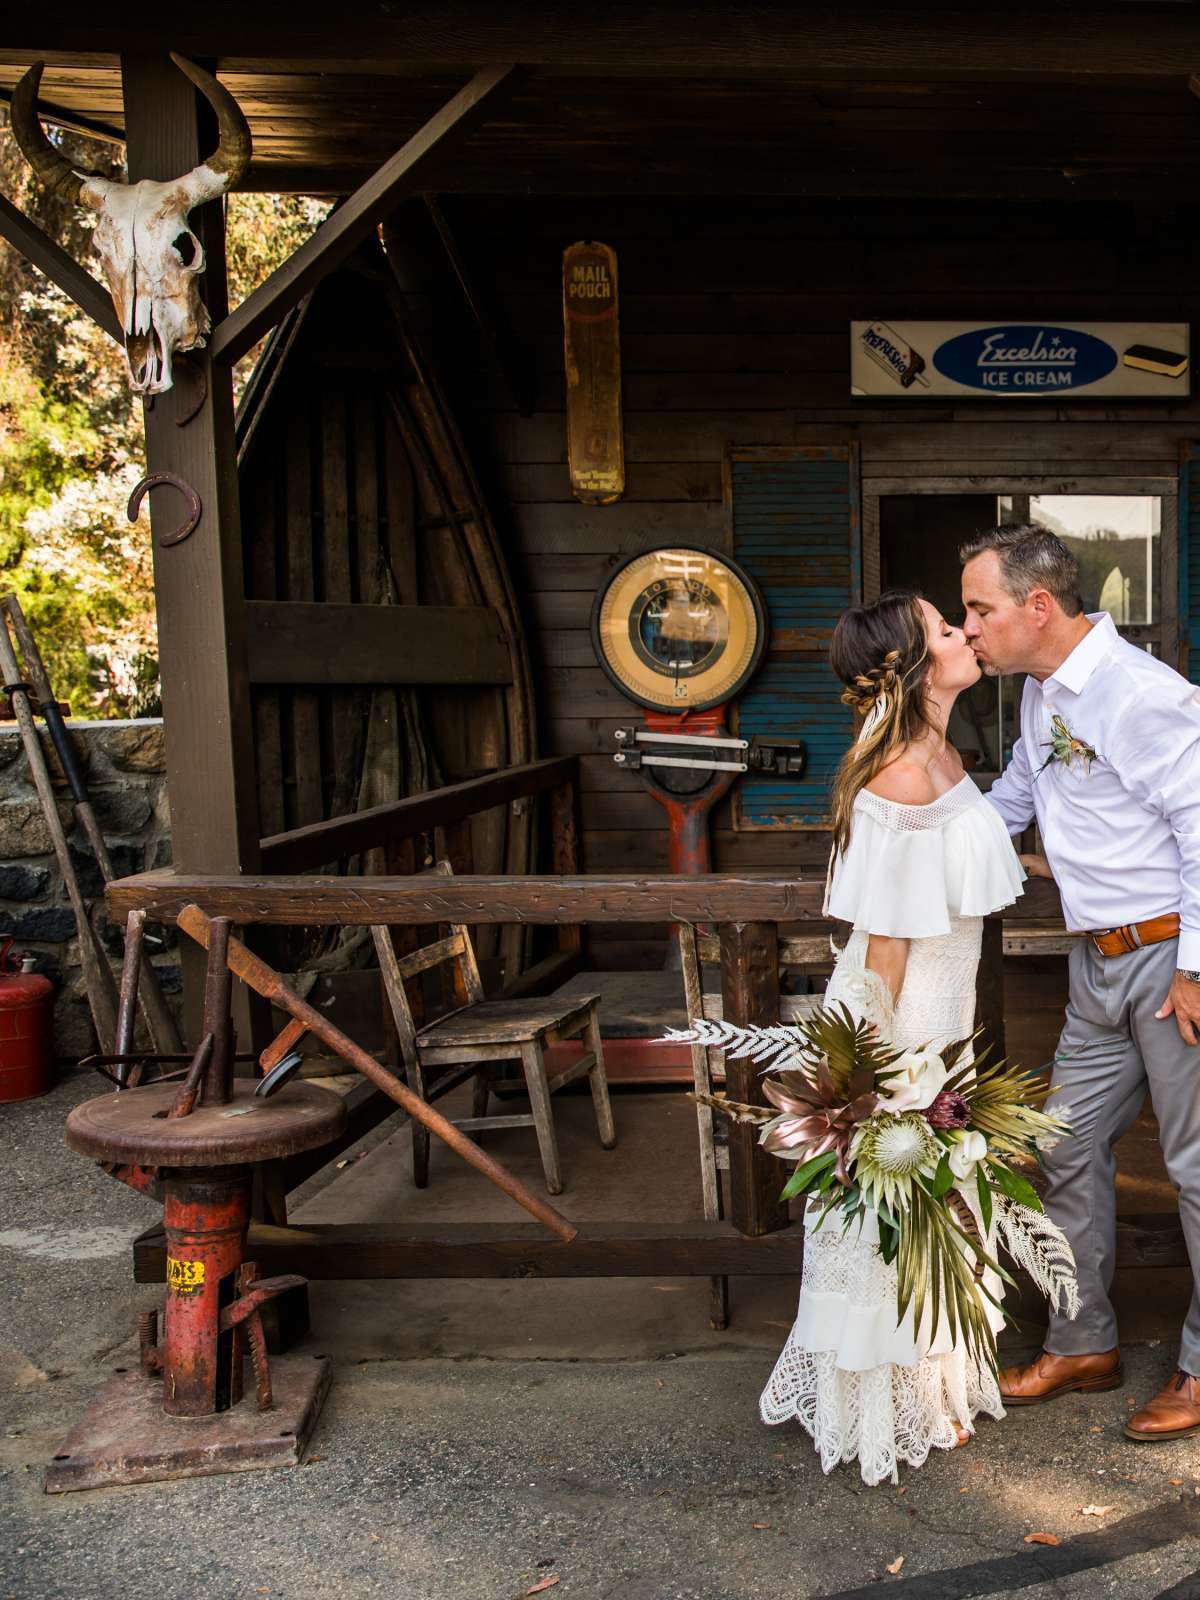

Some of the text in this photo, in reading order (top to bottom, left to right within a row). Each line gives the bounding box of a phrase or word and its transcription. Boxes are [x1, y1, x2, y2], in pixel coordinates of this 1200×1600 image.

[573, 265, 609, 282] MAIL
[569, 282, 610, 298] POUCH
[976, 330, 1078, 367] Excelsior
[982, 370, 1073, 386] ICE CREAM
